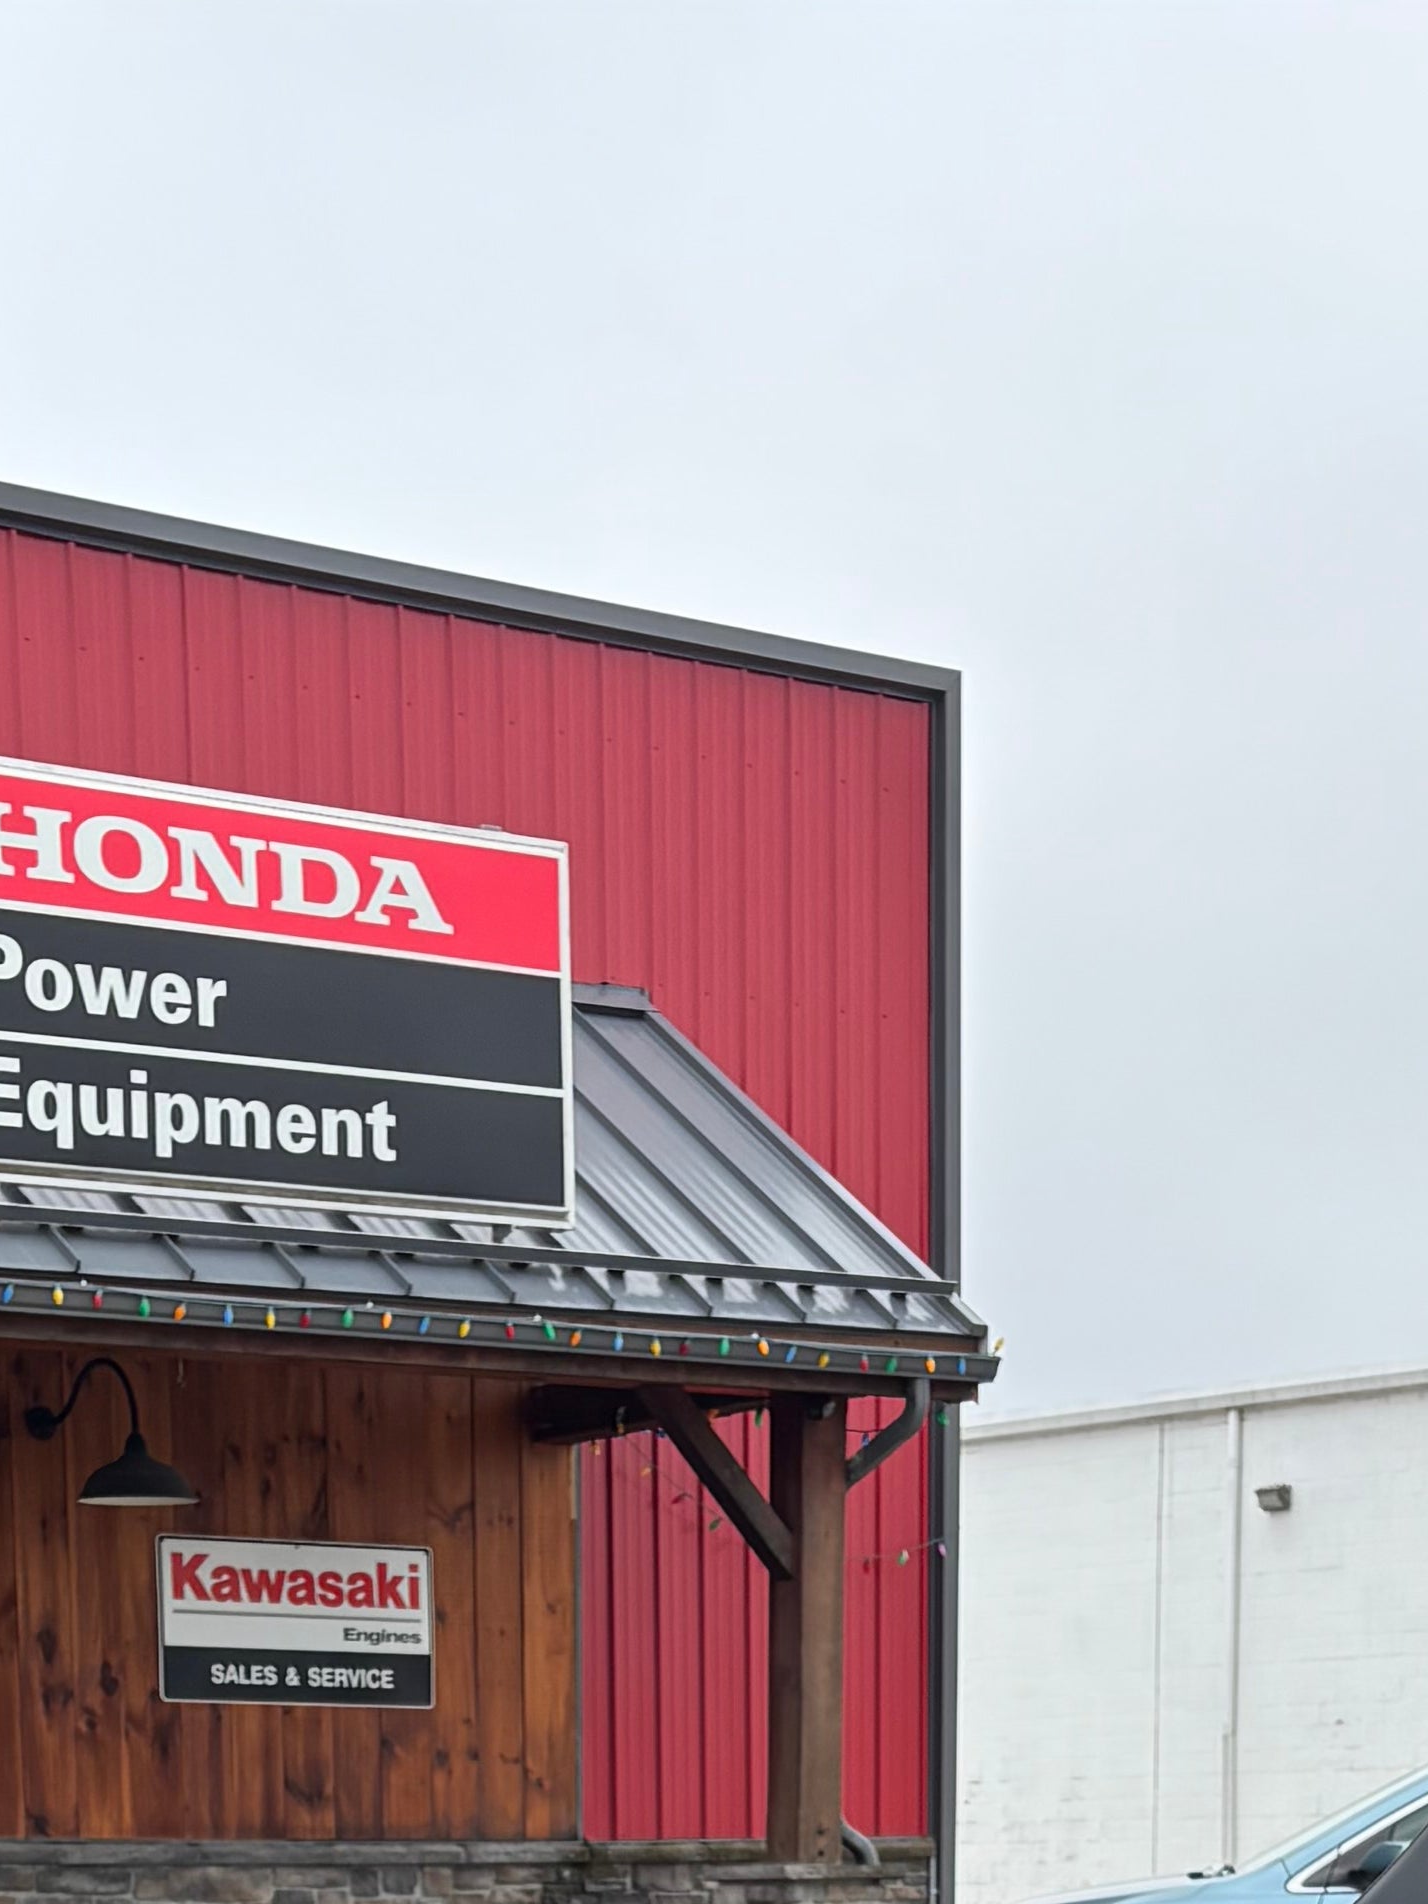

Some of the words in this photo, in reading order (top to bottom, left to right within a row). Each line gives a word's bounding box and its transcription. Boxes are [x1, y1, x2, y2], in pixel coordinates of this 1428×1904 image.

[170, 1551, 422, 1611] Kawasaki
[342, 1626, 422, 1647] Engines
[210, 1663, 279, 1687] SALES
[285, 1666, 301, 1688] &
[307, 1666, 395, 1690] SERVICE
